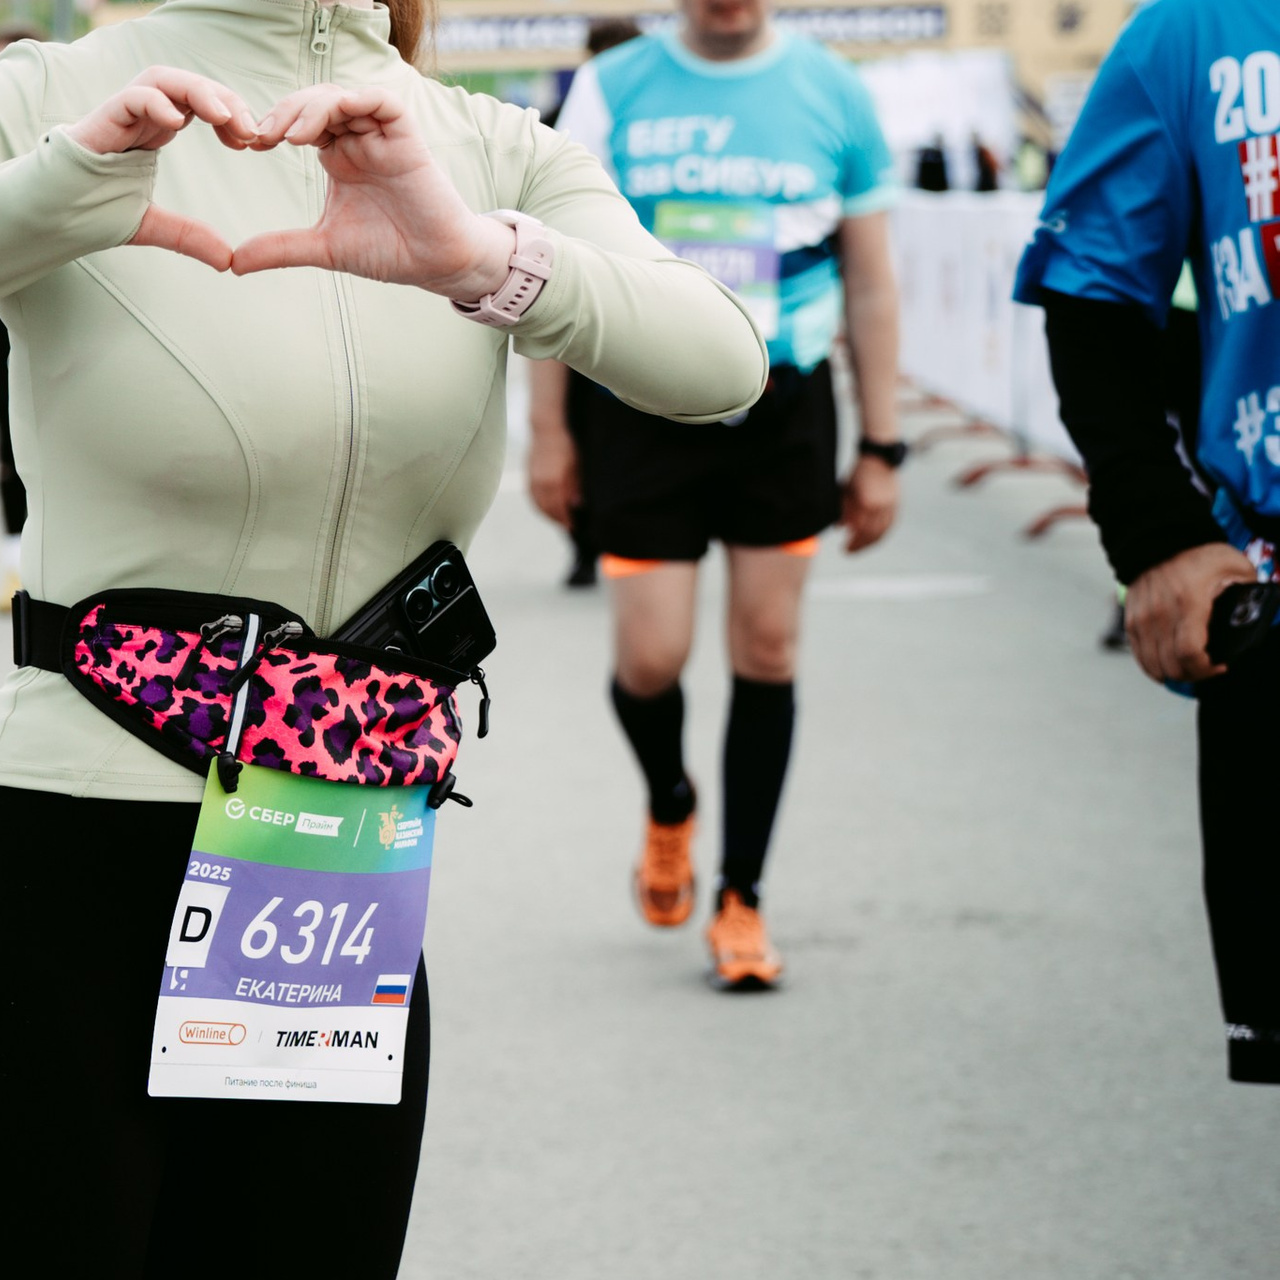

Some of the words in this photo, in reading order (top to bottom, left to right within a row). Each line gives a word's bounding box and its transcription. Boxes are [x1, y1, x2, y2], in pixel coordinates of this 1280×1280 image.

[249, 806, 295, 826] СБЕР
[301, 818, 333, 831] Прайм
[188, 860, 232, 881] 2025
[179, 905, 212, 943] D
[240, 896, 379, 965] 6314
[235, 977, 342, 1003] ЕКАТЕРИНА
[185, 1026, 226, 1040] Winline
[224, 1076, 258, 1087] Питание
[259, 1079, 284, 1088] после
[285, 1080, 317, 1089] финиша
